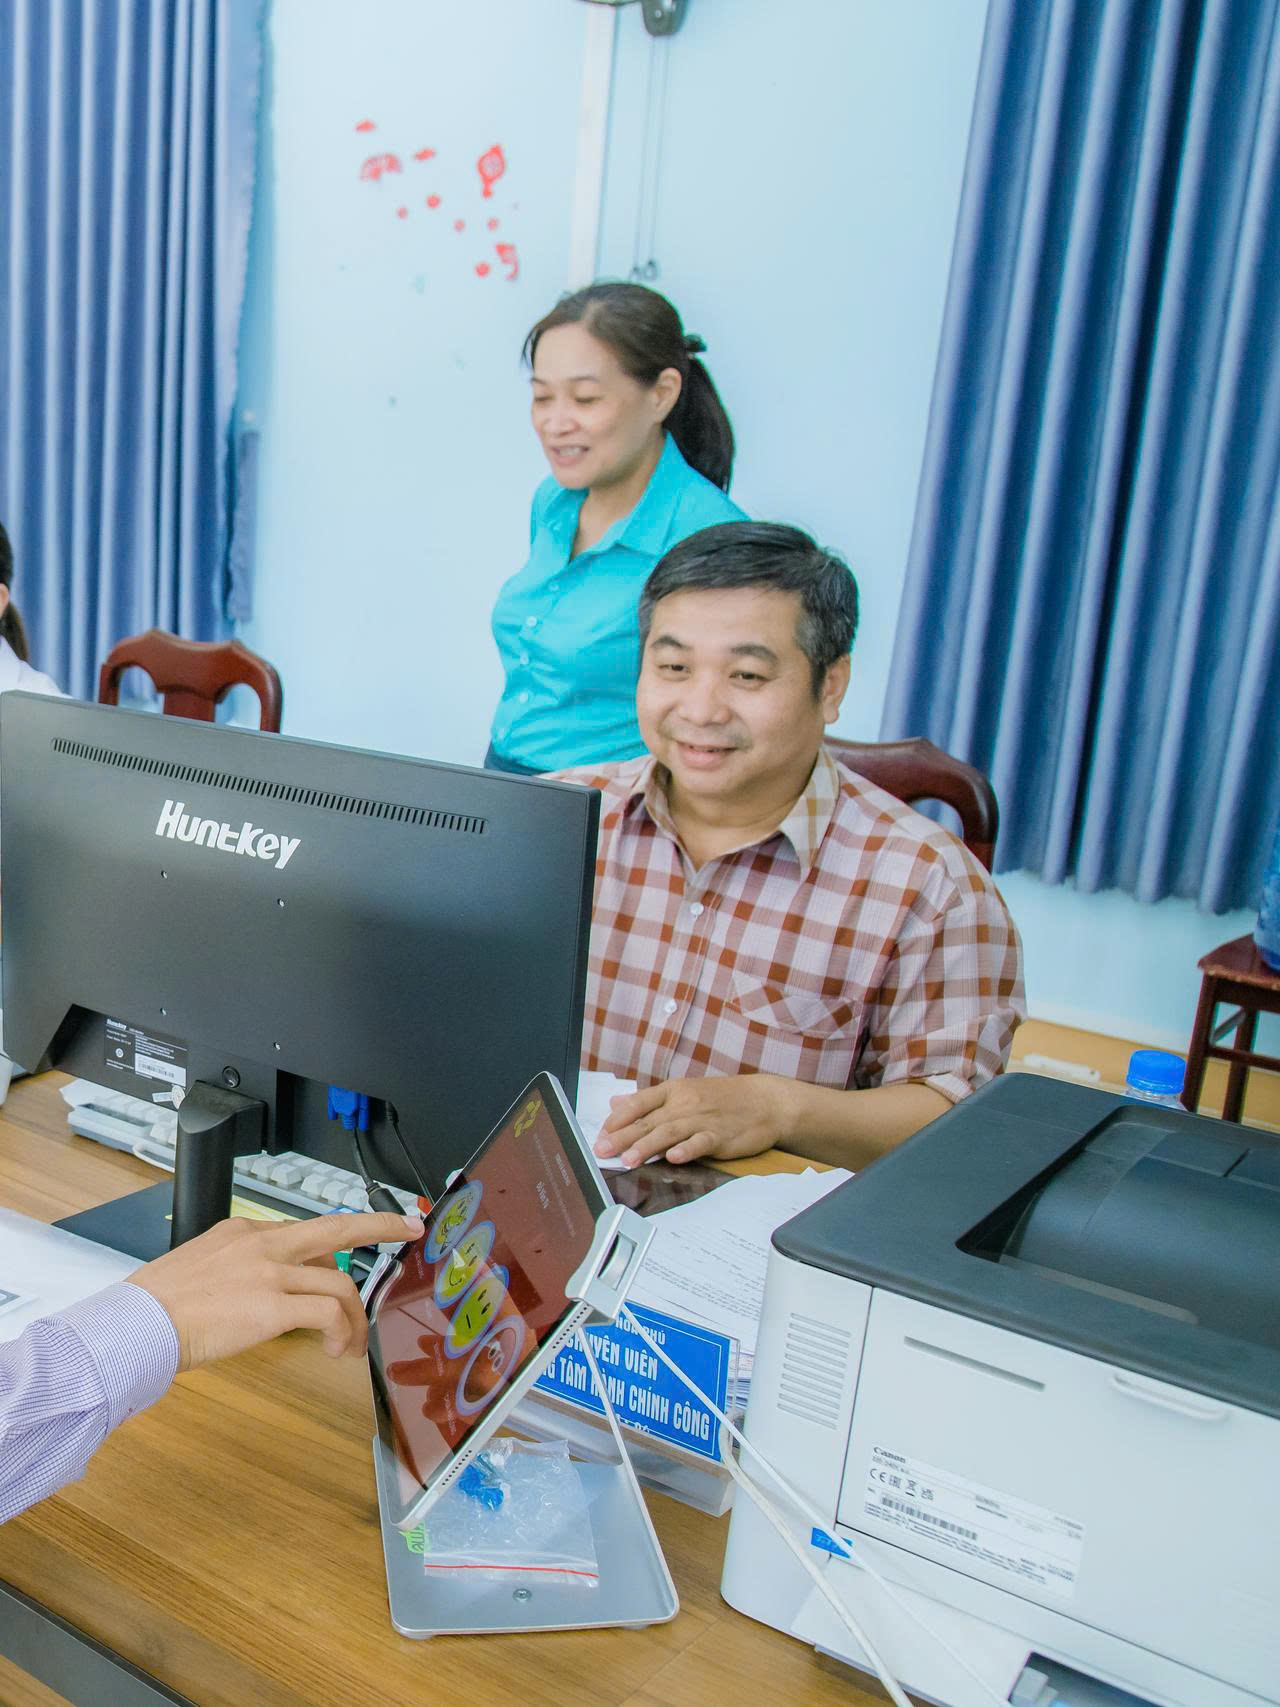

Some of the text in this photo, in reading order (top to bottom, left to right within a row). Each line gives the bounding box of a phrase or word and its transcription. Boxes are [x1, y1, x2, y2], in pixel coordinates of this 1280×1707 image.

[560, 1355, 587, 1392] TÂM
[629, 1384, 669, 1425] CHÍNH
[673, 1401, 710, 1441] CÔNG
[873, 1446, 906, 1464] Canon
